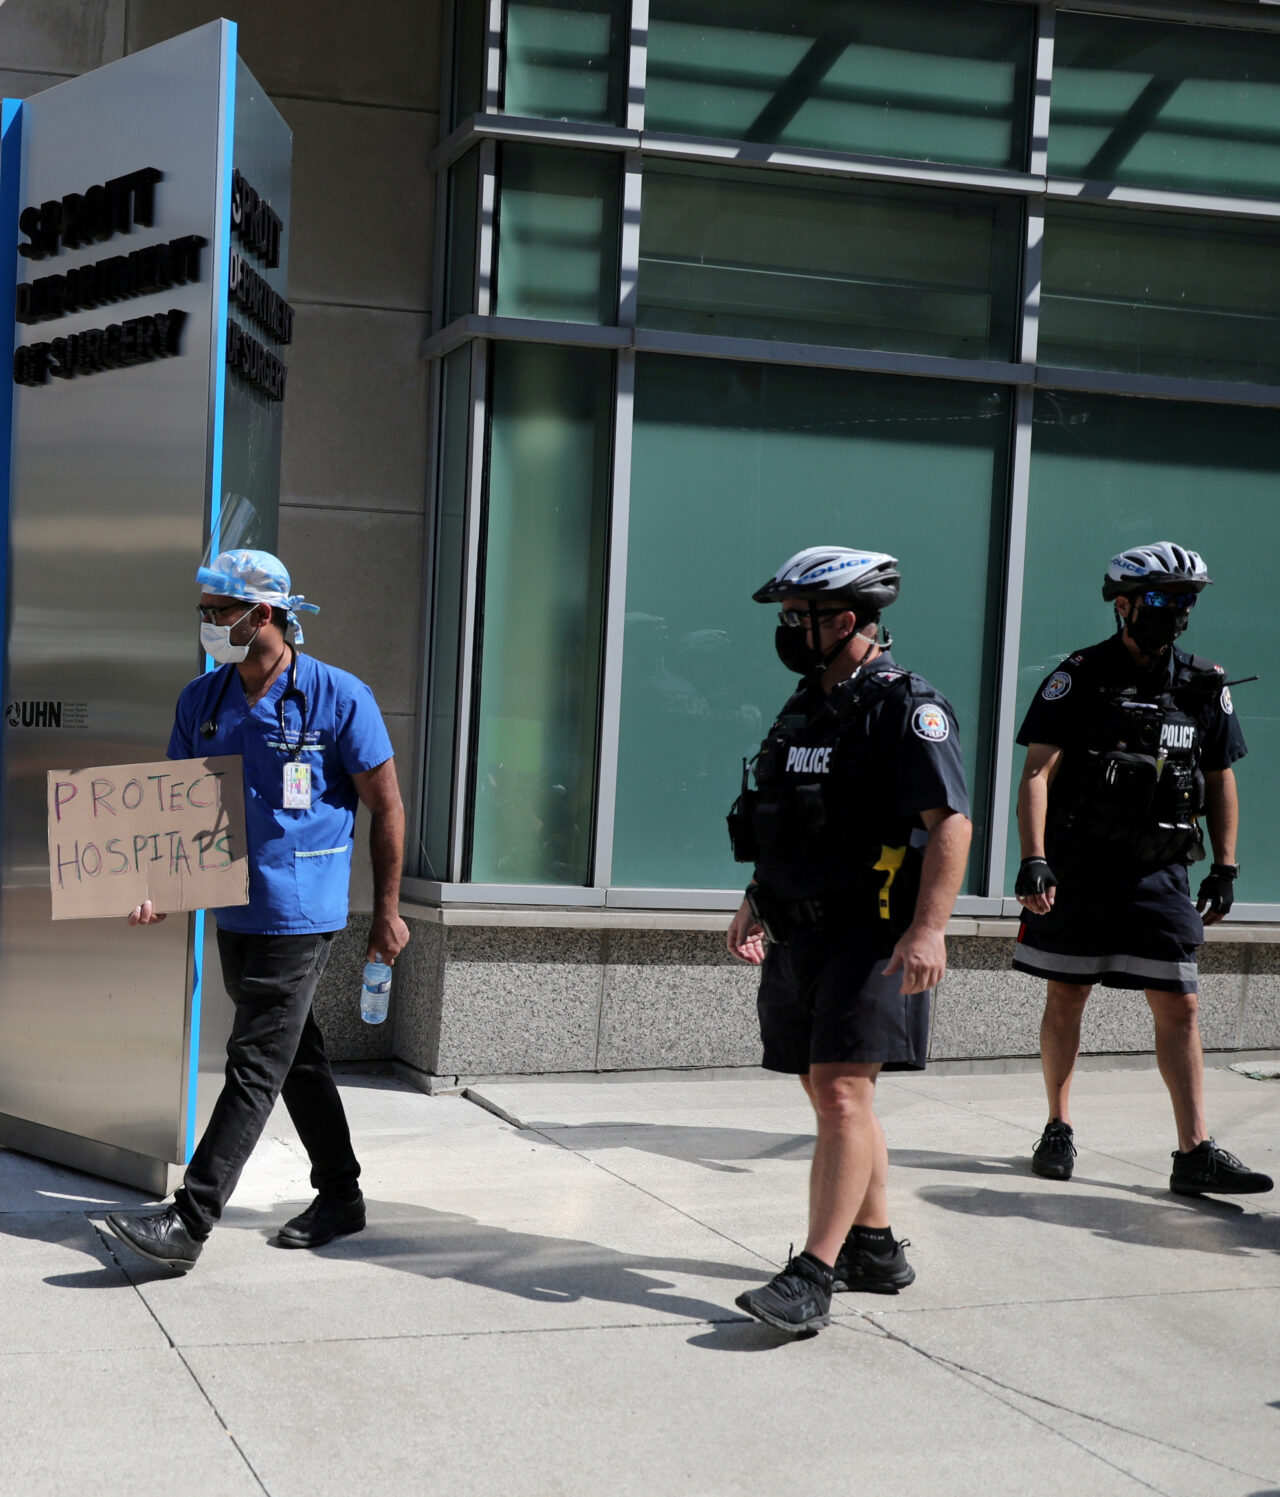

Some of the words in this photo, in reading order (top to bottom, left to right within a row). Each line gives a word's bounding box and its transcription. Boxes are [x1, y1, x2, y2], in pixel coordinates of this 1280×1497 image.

[228, 247, 295, 345] DEPARTMENT
[49, 308, 190, 380] SURGERY
[239, 330, 289, 401] SURGERY
[796, 558, 872, 584] POLICE
[1111, 558, 1147, 576] OLICE
[22, 701, 61, 728] UHN
[1159, 724, 1195, 749] POLICE
[785, 746, 832, 773] POLICE
[55, 772, 227, 823] PROTECT
[57, 831, 235, 889] HOSPITALS
